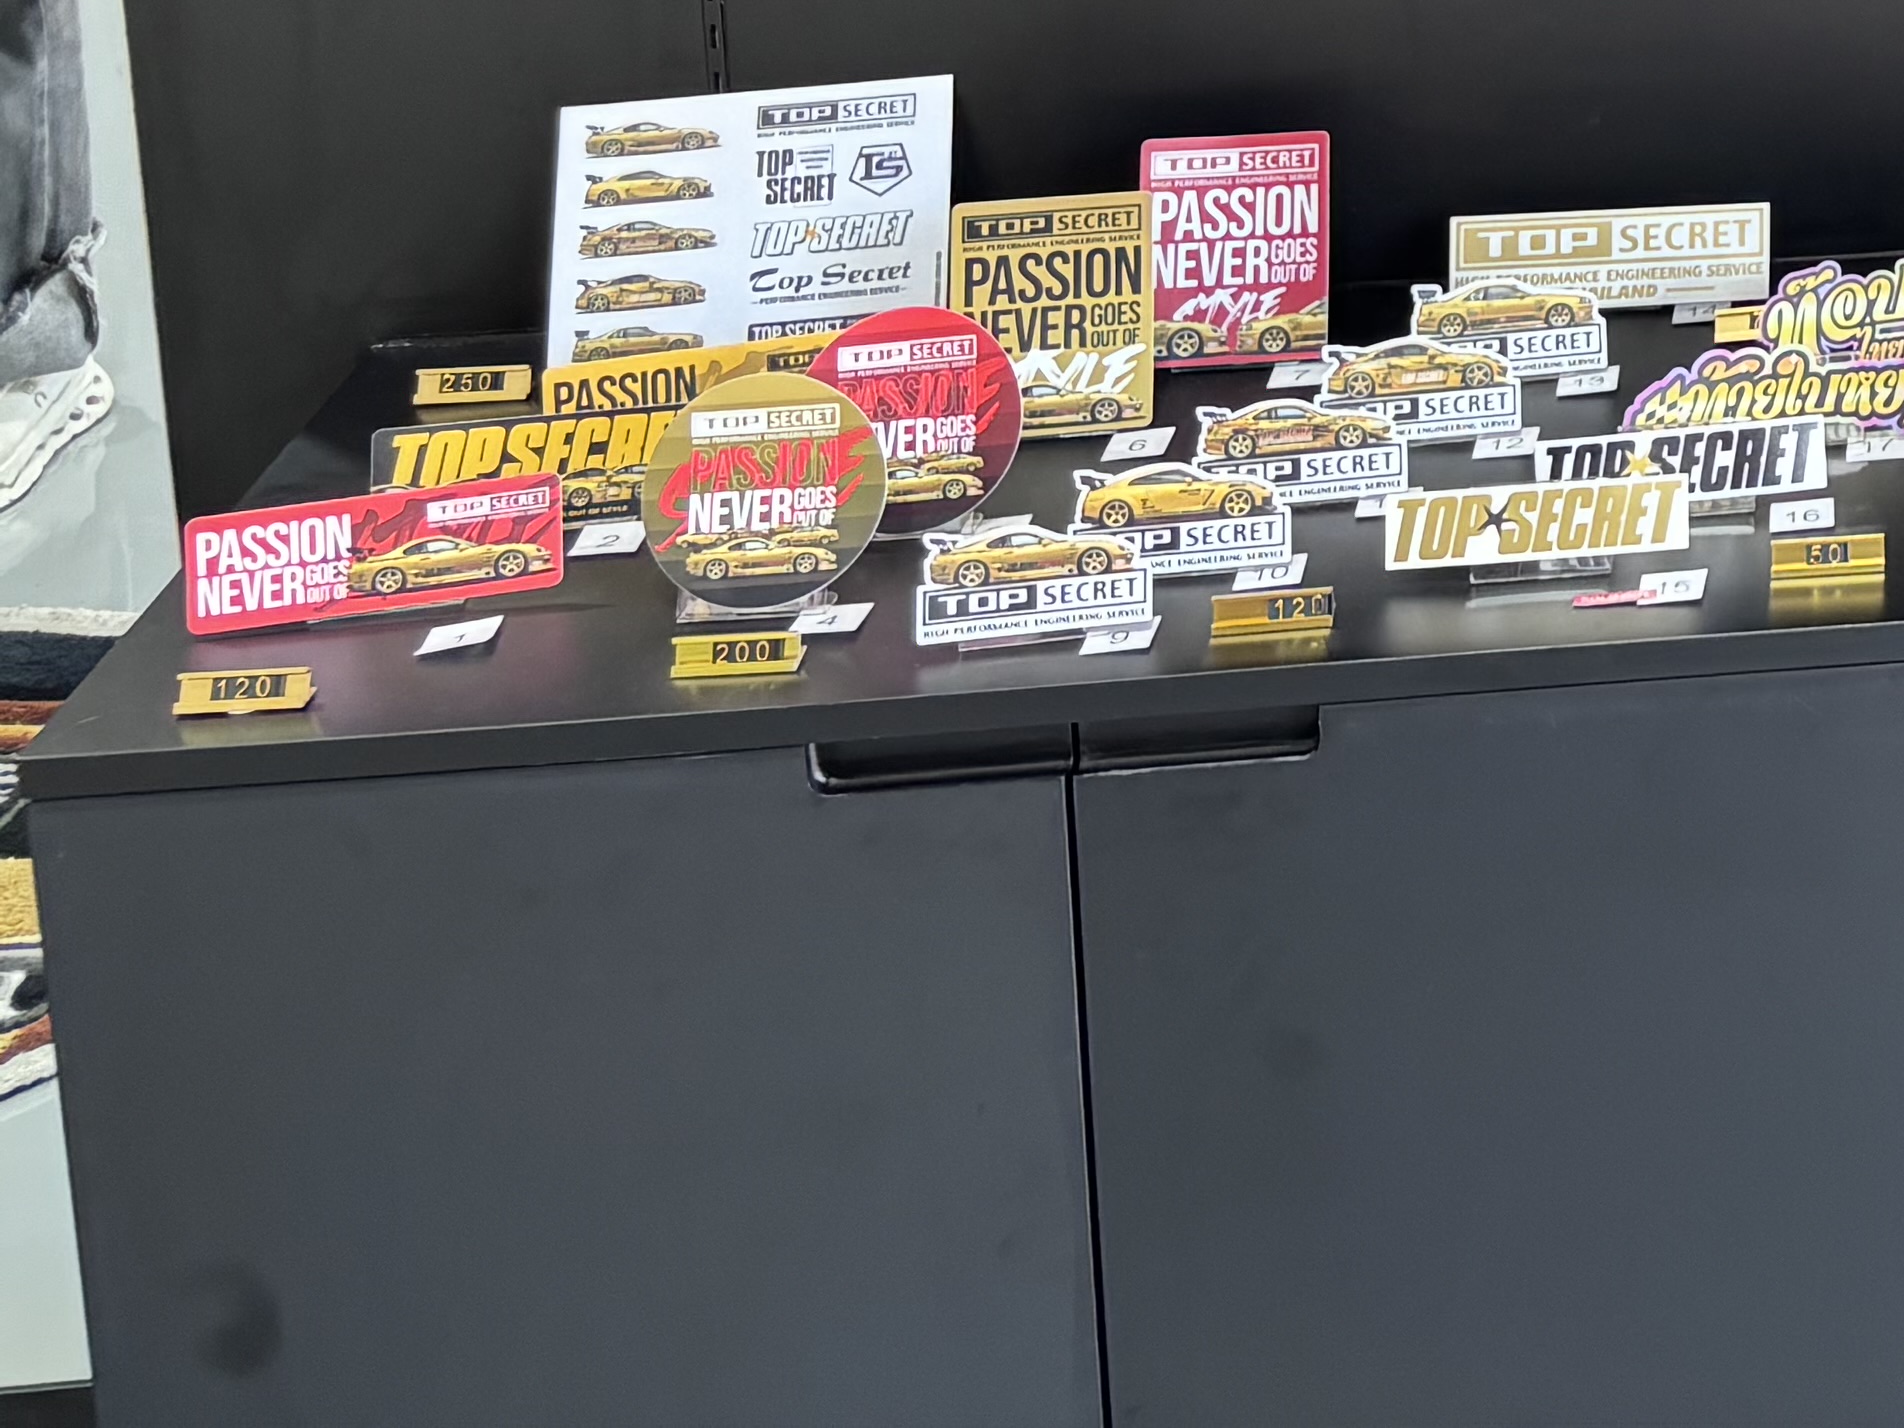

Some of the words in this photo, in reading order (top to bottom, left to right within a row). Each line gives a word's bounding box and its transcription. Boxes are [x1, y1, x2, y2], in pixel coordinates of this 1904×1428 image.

[767, 104, 833, 125] TOP
[842, 98, 909, 119] SECRET
[756, 148, 794, 178] TOP
[1164, 156, 1232, 173] TOP
[1242, 150, 1313, 171] SECRET
[765, 173, 837, 205] SECRET
[973, 218, 1048, 236] TOP
[1056, 210, 1135, 232] SECRET
[1152, 184, 1320, 241] PASSION
[750, 219, 810, 260] TOP
[808, 209, 914, 254] SECRET
[1477, 226, 1598, 257] TOP
[1618, 219, 1752, 254] SECRET
[1271, 236, 1319, 264] GOES
[749, 267, 814, 294] Top
[820, 261, 912, 286] Secret
[963, 245, 1142, 308] PASSION
[1153, 239, 1269, 290] NEVER
[1271, 265, 1298, 284] OUT
[1299, 263, 1317, 282] OF
[1606, 266, 1703, 281] ENGINEERING
[1705, 261, 1765, 277] SERVICE
[1090, 301, 1142, 328] GOES
[912, 339, 972, 359] SECRET
[1091, 329, 1119, 349] OUT
[1121, 326, 1141, 346] OF
[1513, 331, 1594, 355] SECRET
[442, 372, 492, 393] 250
[553, 363, 697, 415] PASSION
[768, 407, 837, 427] SECRET
[1424, 392, 1508, 417] SECRET
[936, 414, 977, 438] GOES
[1127, 439, 1148, 452] 6
[1492, 437, 1524, 451] 12
[692, 437, 840, 492] PASSION
[1306, 451, 1395, 477] SECRET
[1650, 421, 1819, 494] SECRET
[491, 493, 546, 509] SECRET
[687, 487, 794, 534] NEVER
[793, 485, 838, 510] GOES
[1393, 495, 1484, 563] TOP
[1496, 480, 1684, 555] SECRET
[1785, 508, 1821, 525] 16
[195, 513, 355, 578] PASSION
[1186, 520, 1275, 546] SECRET
[305, 557, 350, 585] GOES
[196, 564, 306, 618] NEVER
[306, 584, 334, 604] OUT
[333, 583, 349, 600] OF
[938, 590, 1029, 614] TOP
[1043, 576, 1138, 605] SECRET
[1273, 593, 1324, 618] 120
[715, 640, 770, 664] 200
[215, 678, 271, 700] 120
